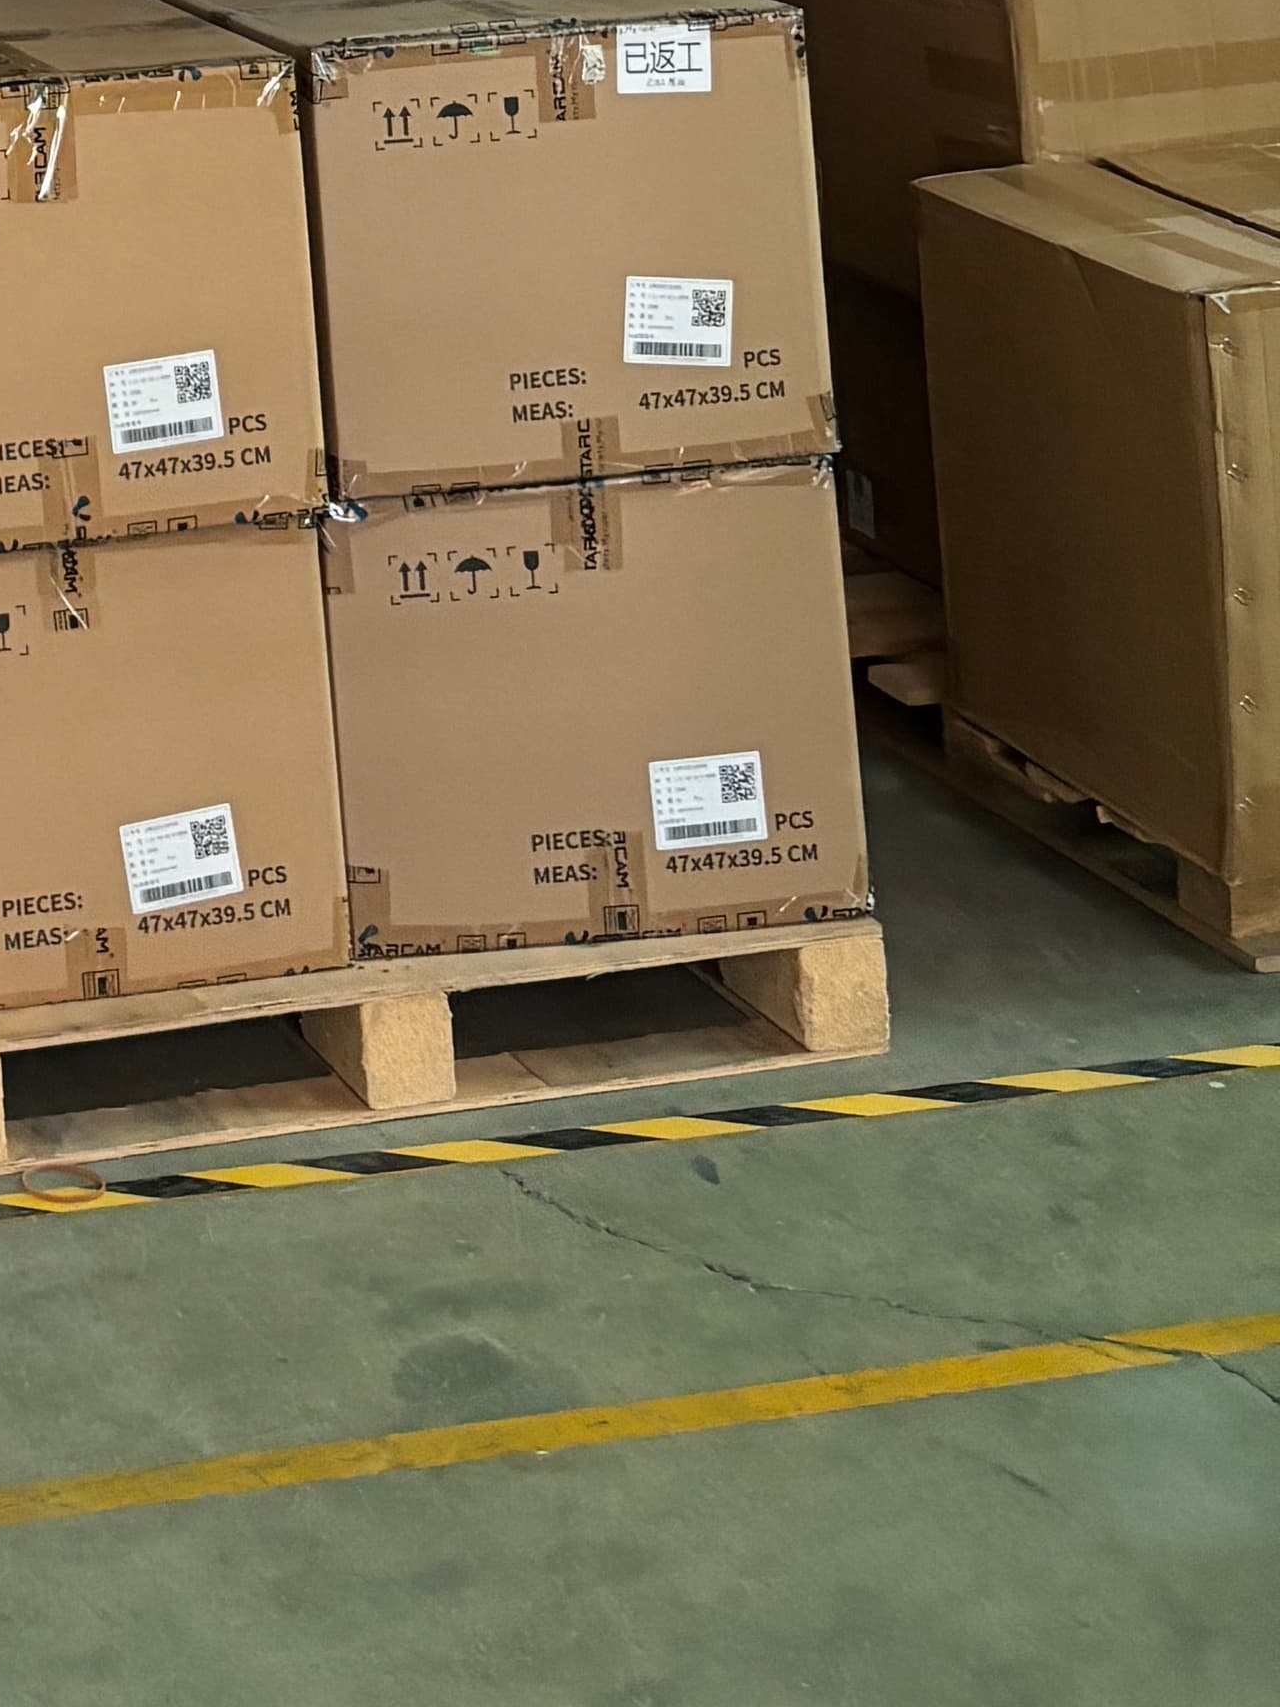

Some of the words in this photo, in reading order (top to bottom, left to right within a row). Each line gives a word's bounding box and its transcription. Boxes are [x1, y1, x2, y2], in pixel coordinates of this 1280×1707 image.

[624, 41, 704, 74] 已返工
[509, 368, 587, 391] PIECES:
[743, 349, 781, 368] PCS
[512, 401, 574, 423] MEAS:
[639, 383, 750, 410] 47x47x39.5
[756, 380, 786, 400] CM
[228, 414, 267, 436] PCS
[119, 450, 235, 480] 47x47x39.5
[241, 446, 272, 468] CM
[532, 829, 610, 853] PIECES:
[774, 812, 814, 832] PCS
[534, 863, 597, 885] MEAS:
[666, 848, 782, 874] 47x47x39.5
[788, 844, 819, 864] CM
[2, 892, 82, 918] PIECES:
[248, 866, 287, 888] PCS
[138, 903, 255, 935] 47x47x39.5
[261, 898, 291, 919] CM
